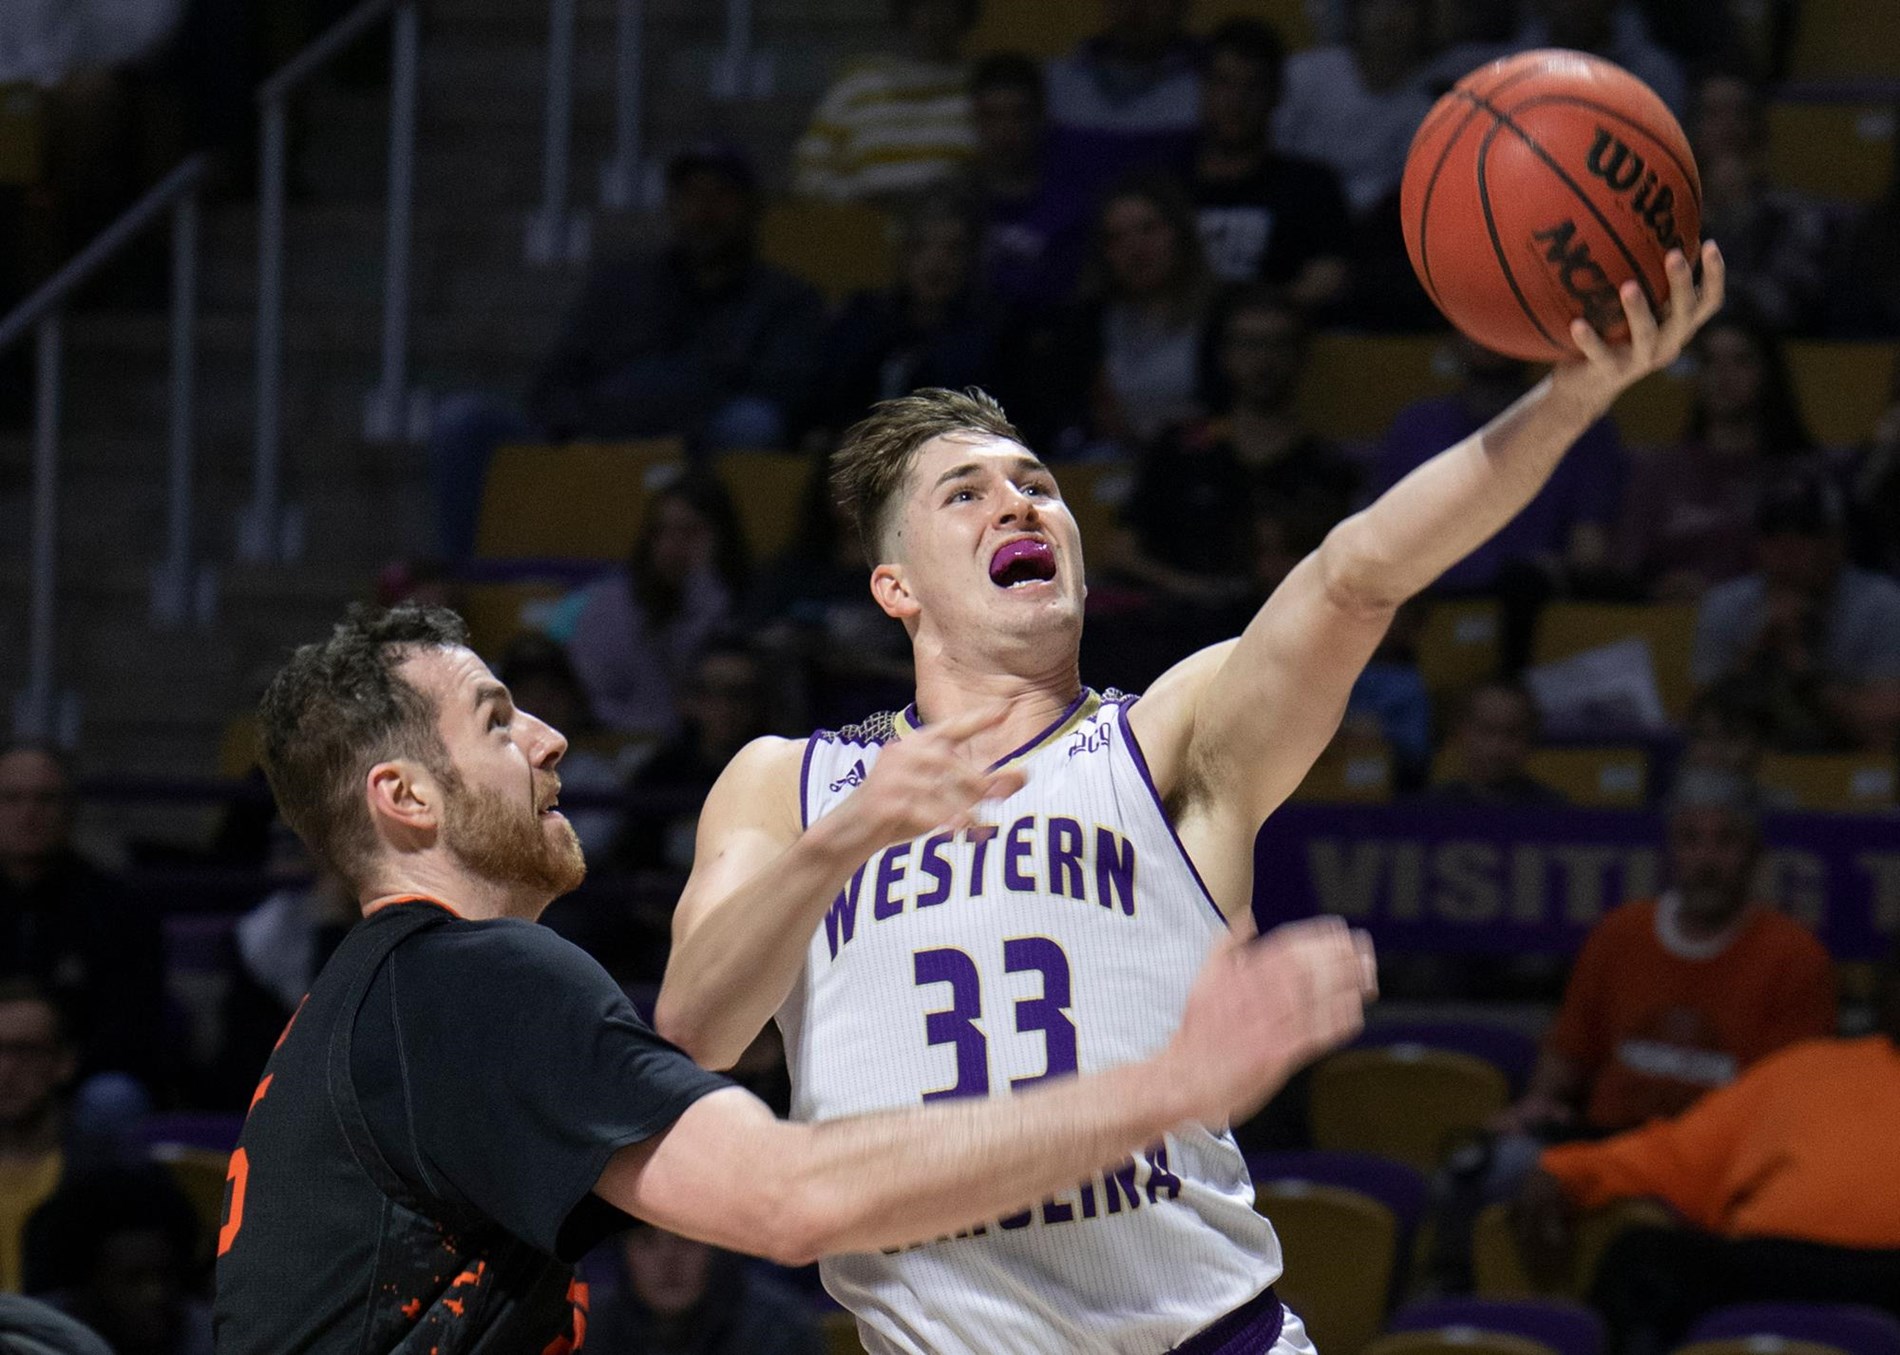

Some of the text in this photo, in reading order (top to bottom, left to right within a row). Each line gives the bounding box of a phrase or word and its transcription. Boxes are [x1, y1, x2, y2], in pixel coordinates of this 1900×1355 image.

[1586, 127, 1690, 254] Wils
[824, 815, 1135, 962] WESTERN
[1308, 839, 1826, 929] VISITIG
[912, 935, 1079, 1105] 33
